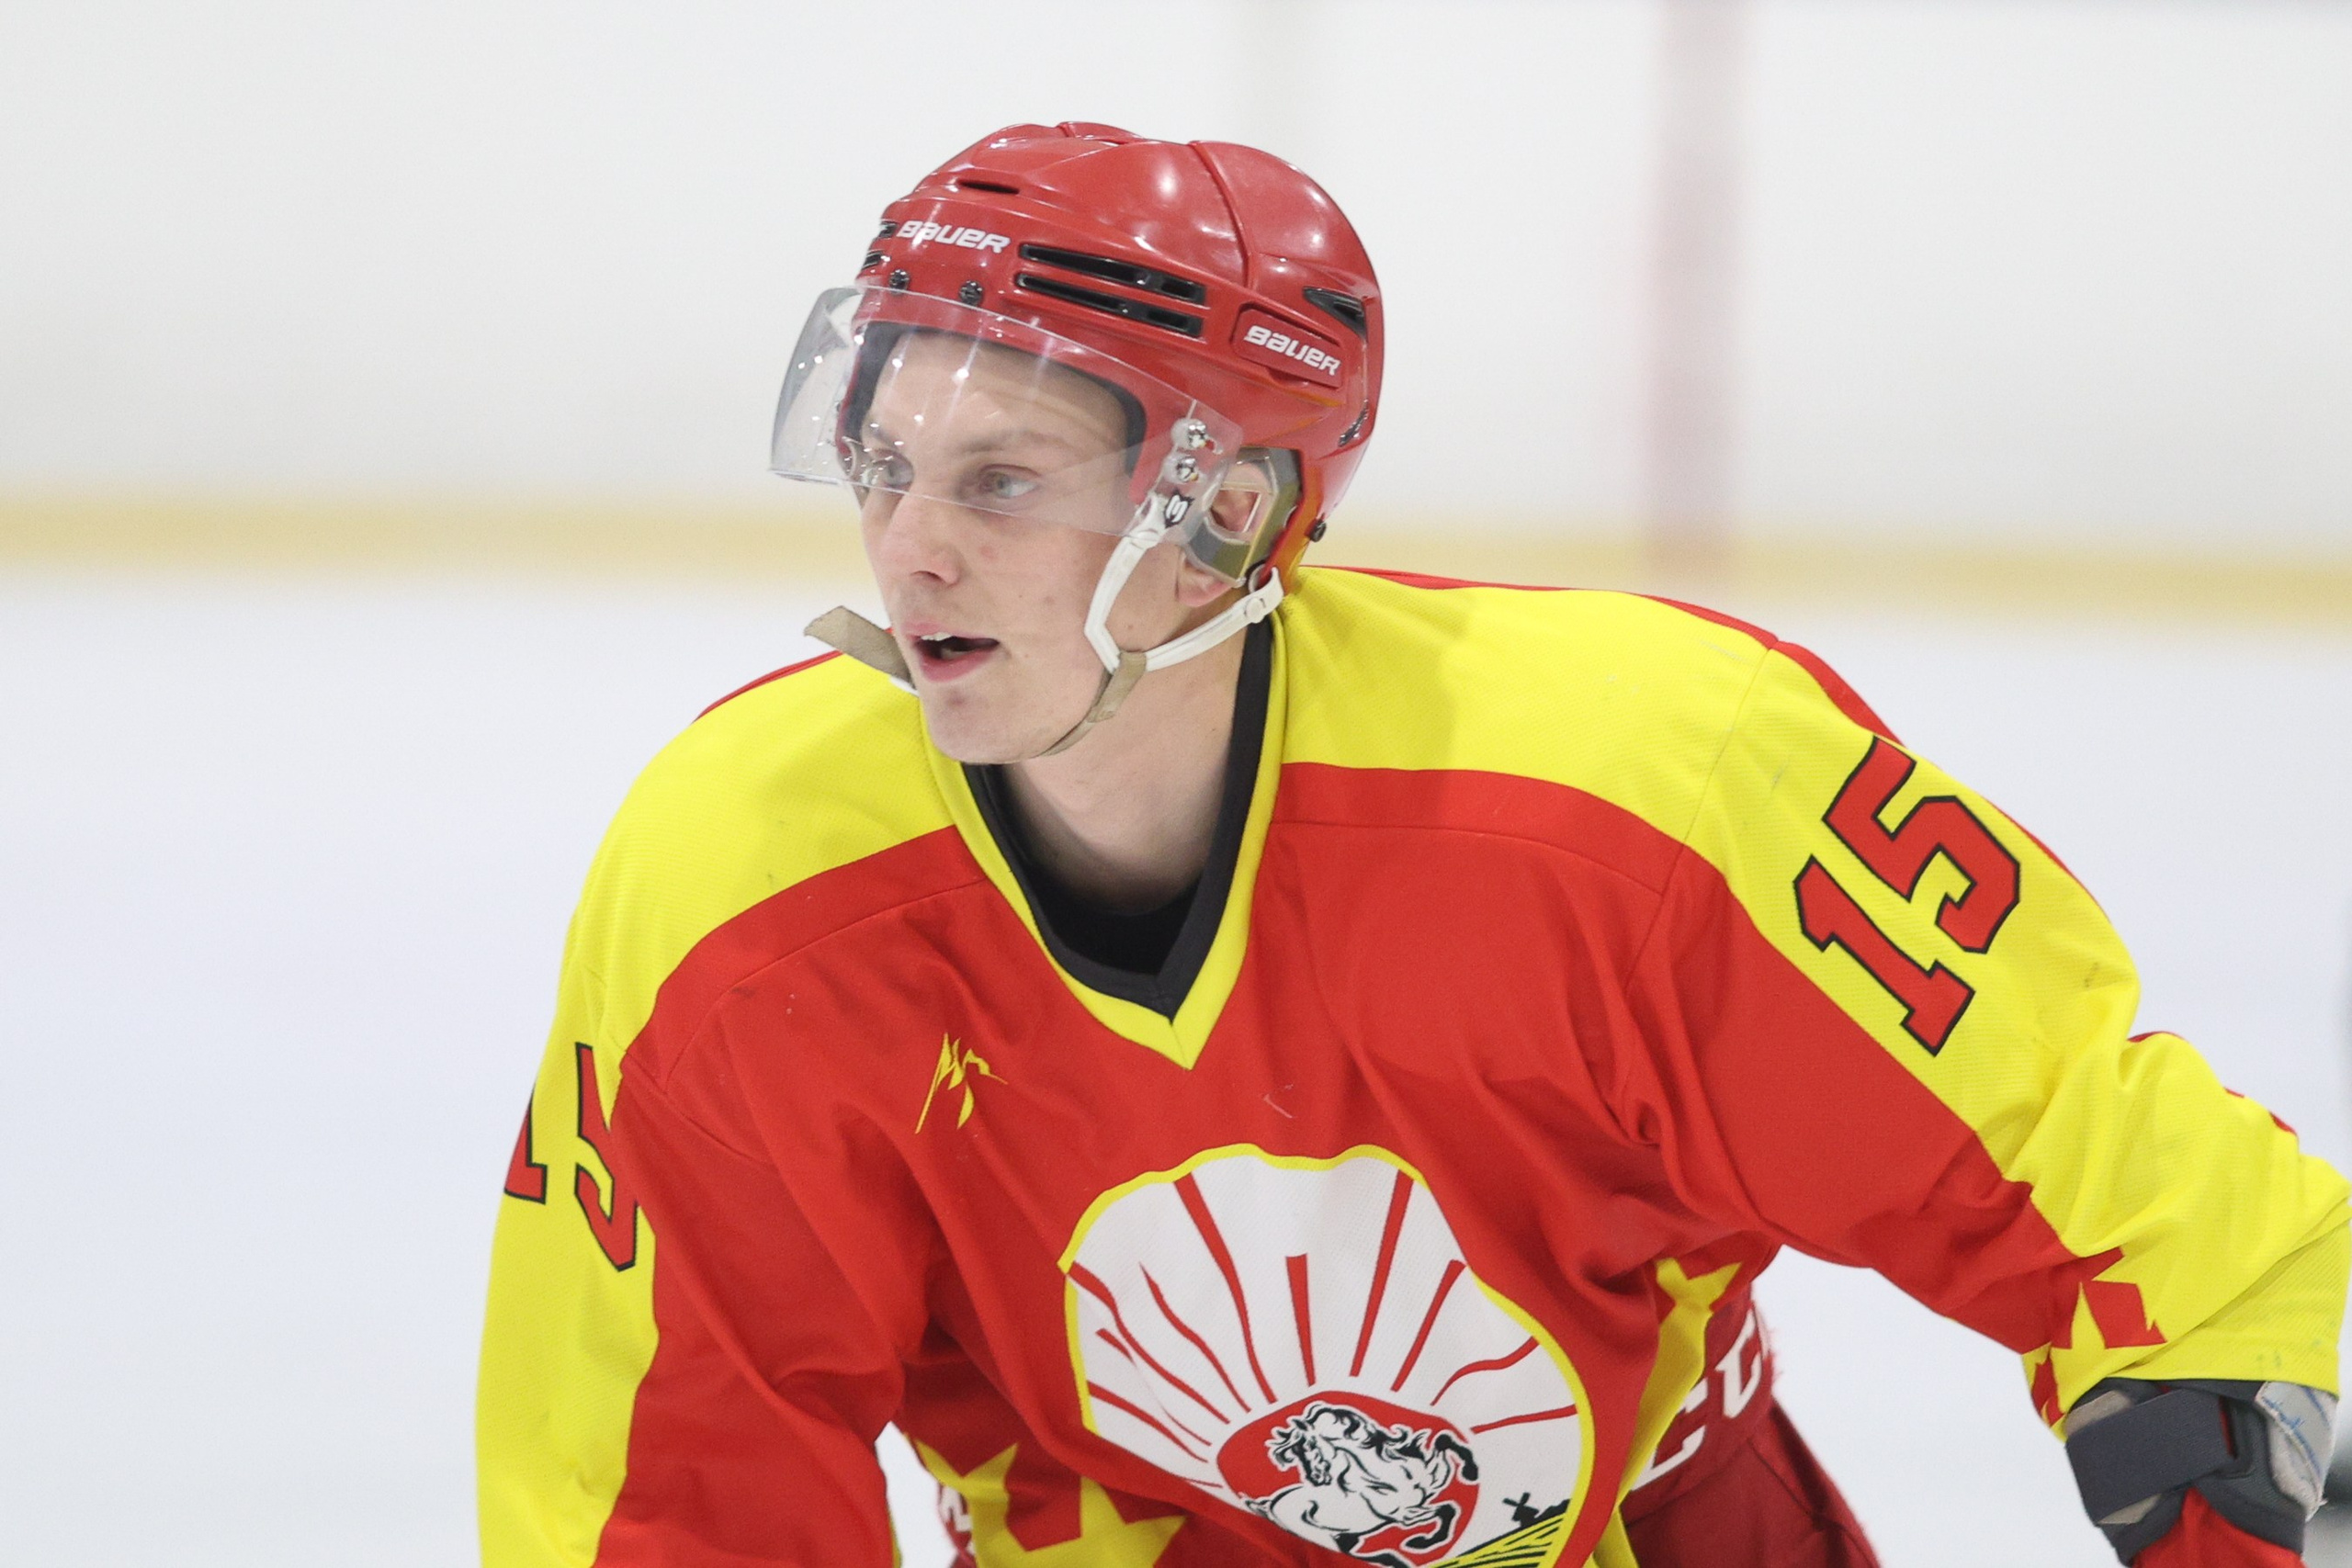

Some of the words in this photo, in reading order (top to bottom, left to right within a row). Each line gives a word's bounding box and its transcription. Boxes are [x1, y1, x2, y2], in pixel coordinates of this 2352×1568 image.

[896, 220, 1012, 254] BAUER
[1243, 325, 1341, 377] BAUER
[1792, 734, 2020, 1057] 15
